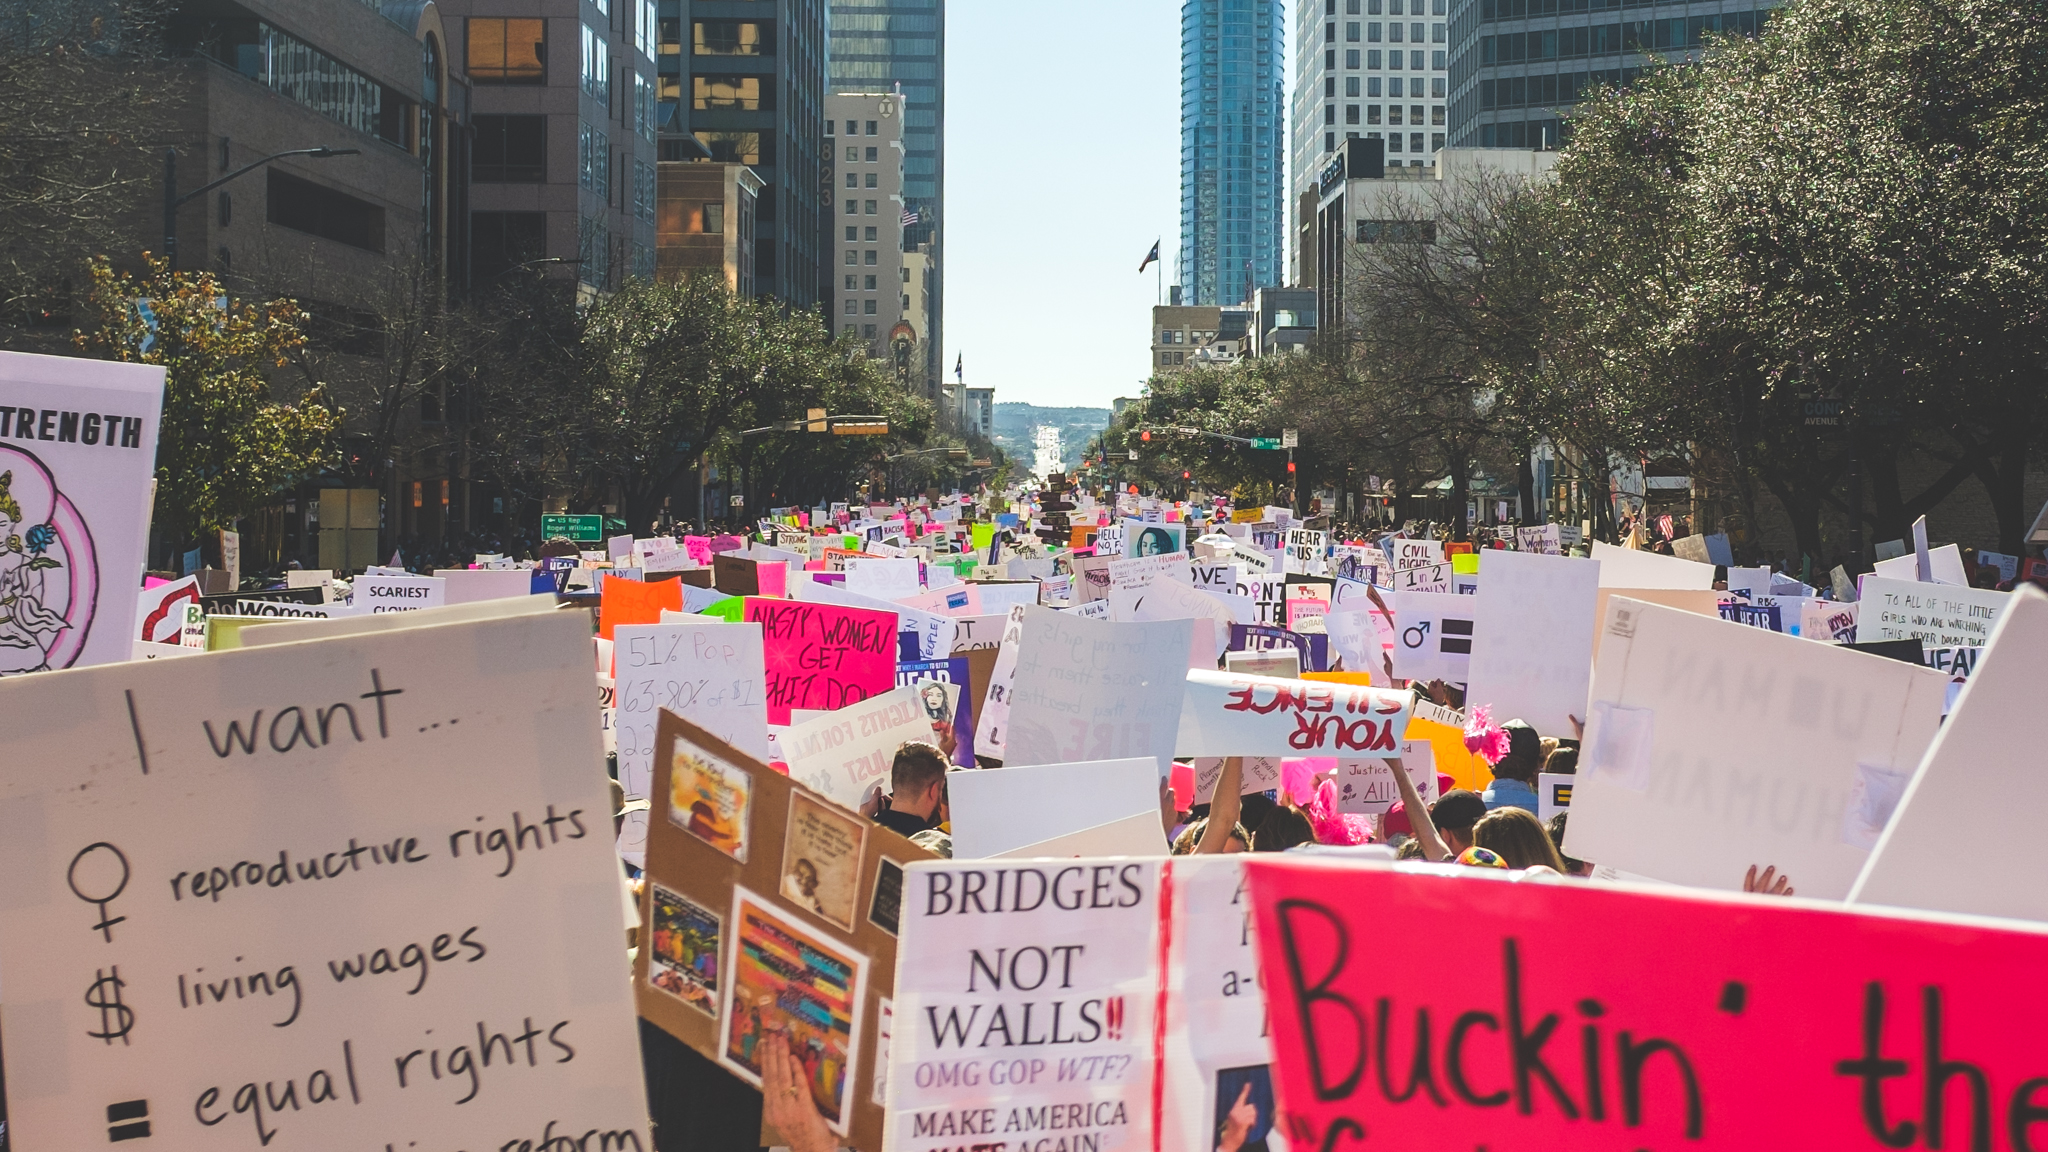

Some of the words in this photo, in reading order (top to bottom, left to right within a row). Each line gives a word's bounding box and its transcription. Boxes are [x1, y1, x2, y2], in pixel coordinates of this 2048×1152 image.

[1804, 417, 1839, 426] AVENUE
[546, 524, 566, 532] Roger
[568, 524, 597, 532] Williams
[568, 517, 581, 525] Rep
[1519, 525, 1547, 536] National
[780, 534, 807, 545] STRONG
[1097, 528, 1117, 541] HELL
[1290, 530, 1321, 546] HEAR
[1522, 535, 1558, 549] Women's
[1158, 553, 1186, 564] HUMAN
[1234, 551, 1266, 569] MOTHER
[1297, 546, 1313, 561] US
[1402, 543, 1431, 559] CIVIL
[1406, 570, 1417, 587] 1
[1432, 565, 1444, 583] 2
[369, 585, 430, 599] SCARIEST
[1757, 597, 1777, 606] RBG
[1884, 593, 1899, 606] TO
[1905, 595, 1921, 609] ALL
[1926, 597, 1938, 610] OF
[1943, 600, 1965, 614] THE
[1968, 604, 1997, 620] LITTLE
[751, 606, 812, 642] NASTY
[818, 612, 894, 655] WOMEN
[1739, 610, 1771, 630] HEAR
[1881, 610, 1906, 624] GIRLS
[1911, 614, 1928, 627] WHO
[1929, 617, 1945, 629] ARE
[1947, 618, 1987, 636] WATCHING
[920, 617, 946, 660] PEOPLE!
[1909, 630, 1937, 645] NEVER
[1941, 634, 1966, 646] DOUBT
[1968, 636, 1987, 647] THAT
[629, 634, 683, 667] 51%
[798, 643, 850, 672] GET
[707, 688, 726, 707] of
[731, 679, 760, 708] $1
[1224, 680, 1402, 715] SILENCE
[124, 688, 150, 776] I
[1288, 710, 1396, 751] YOUR
[1198, 757, 1225, 782] Planned
[1251, 764, 1267, 783] Rock
[1348, 764, 1388, 776] Justice
[1364, 781, 1398, 801] All!
[169, 835, 430, 904] reproductive
[449, 803, 589, 880] rights
[923, 863, 1143, 917] BRIDGES
[176, 956, 303, 1029] living
[327, 925, 488, 996] wages
[966, 944, 1085, 994] NOT
[924, 995, 1125, 1050] WALLS!!
[194, 1040, 362, 1148] equal
[394, 1016, 577, 1105] rights
[914, 1060, 981, 1090] OMG
[988, 1058, 1046, 1087] GOP
[1055, 1053, 1133, 1083] WTF?
[912, 1108, 997, 1139] MAKE
[1003, 1100, 1129, 1134] AMERICA
